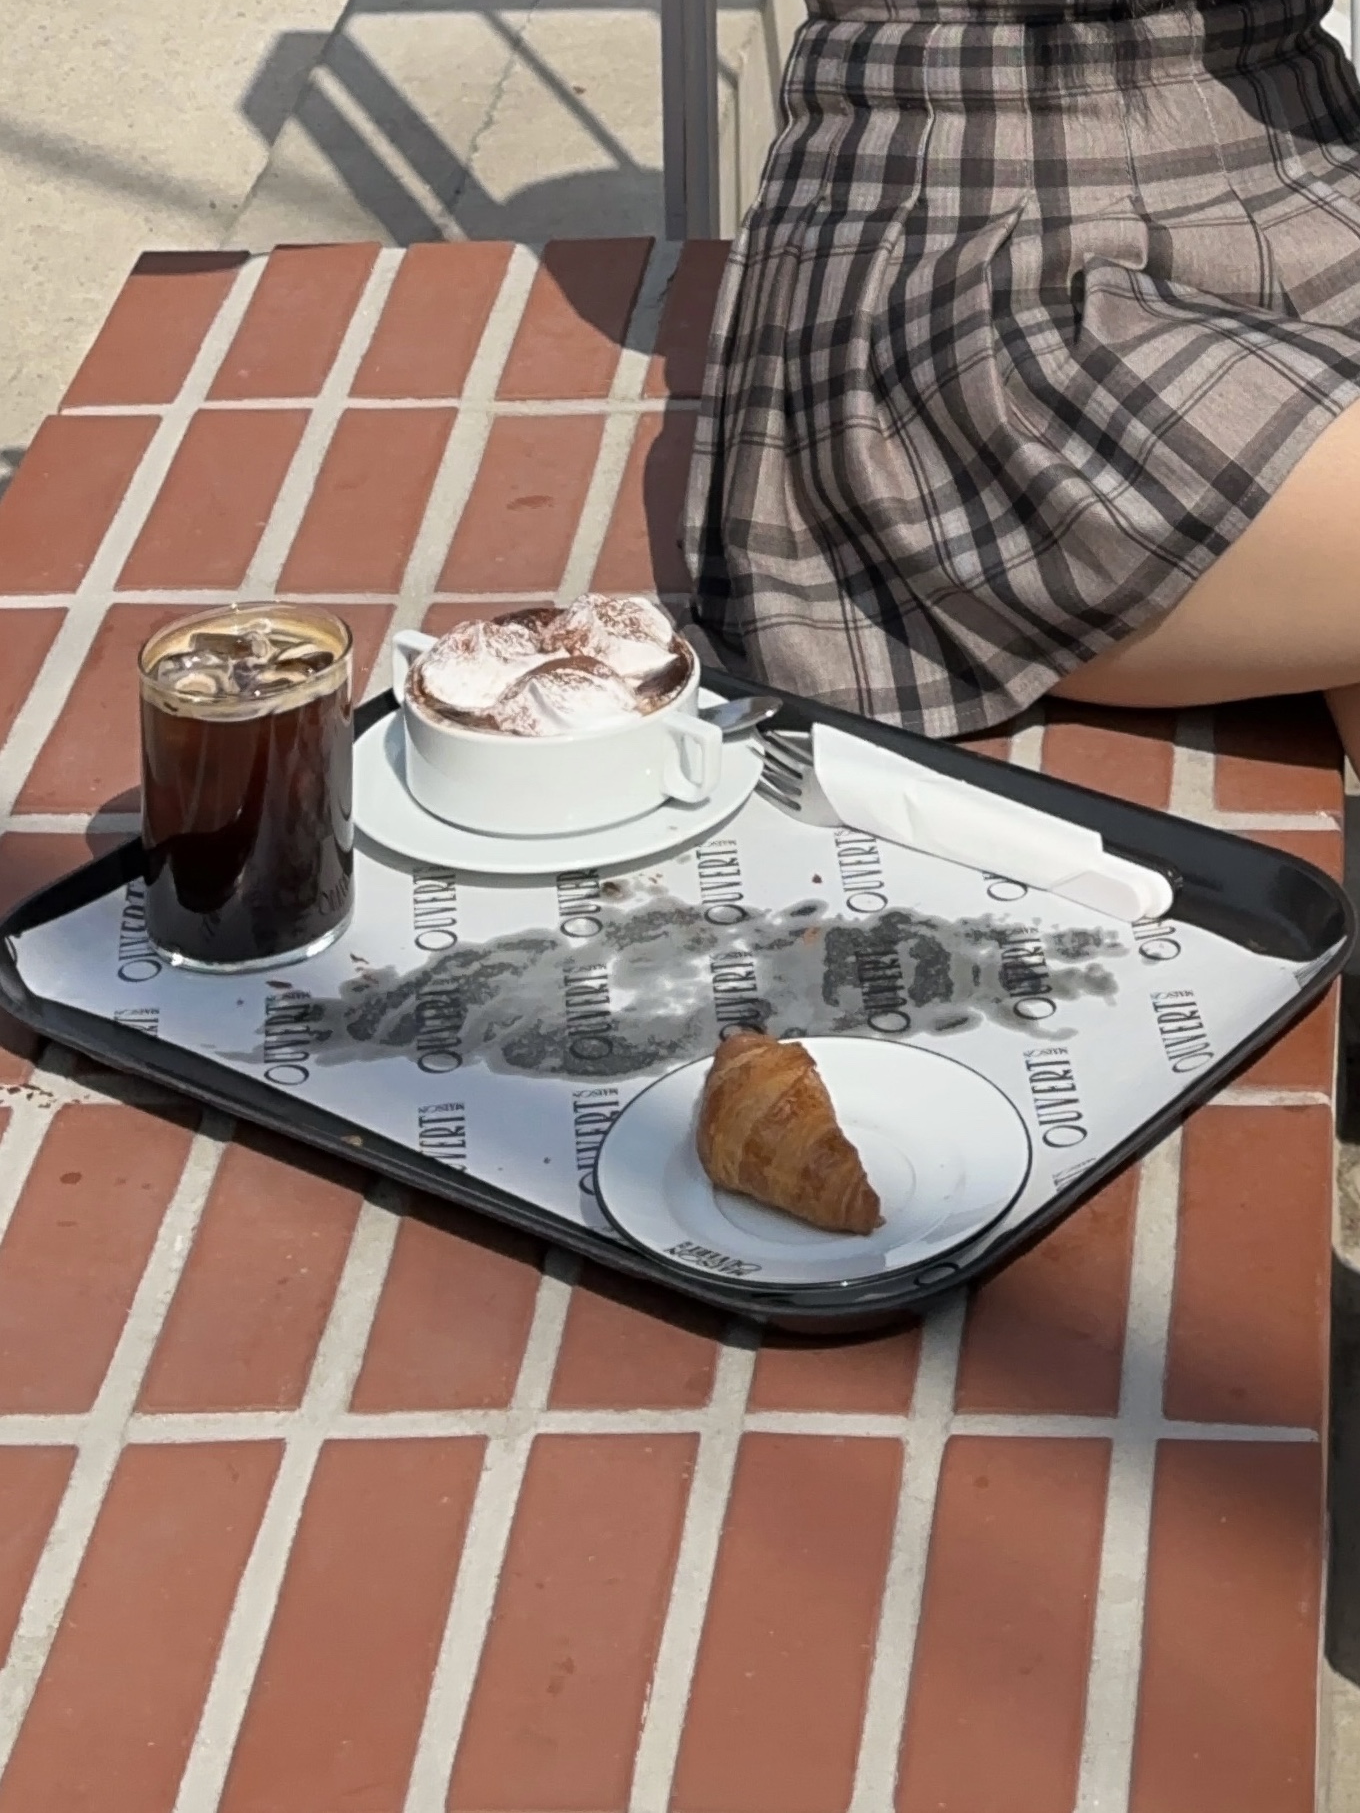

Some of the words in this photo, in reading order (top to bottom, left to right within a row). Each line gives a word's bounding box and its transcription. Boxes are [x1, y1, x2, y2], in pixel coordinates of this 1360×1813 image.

[412, 873, 458, 952] OUVERT
[556, 869, 603, 938] OUVER
[696, 849, 747, 926] OUVERT
[263, 996, 310, 1086] OUVERT
[563, 974, 614, 1060] OUVERT
[1153, 1000, 1214, 1074] OUVERT
[1025, 1059, 1088, 1149] OUVERT
